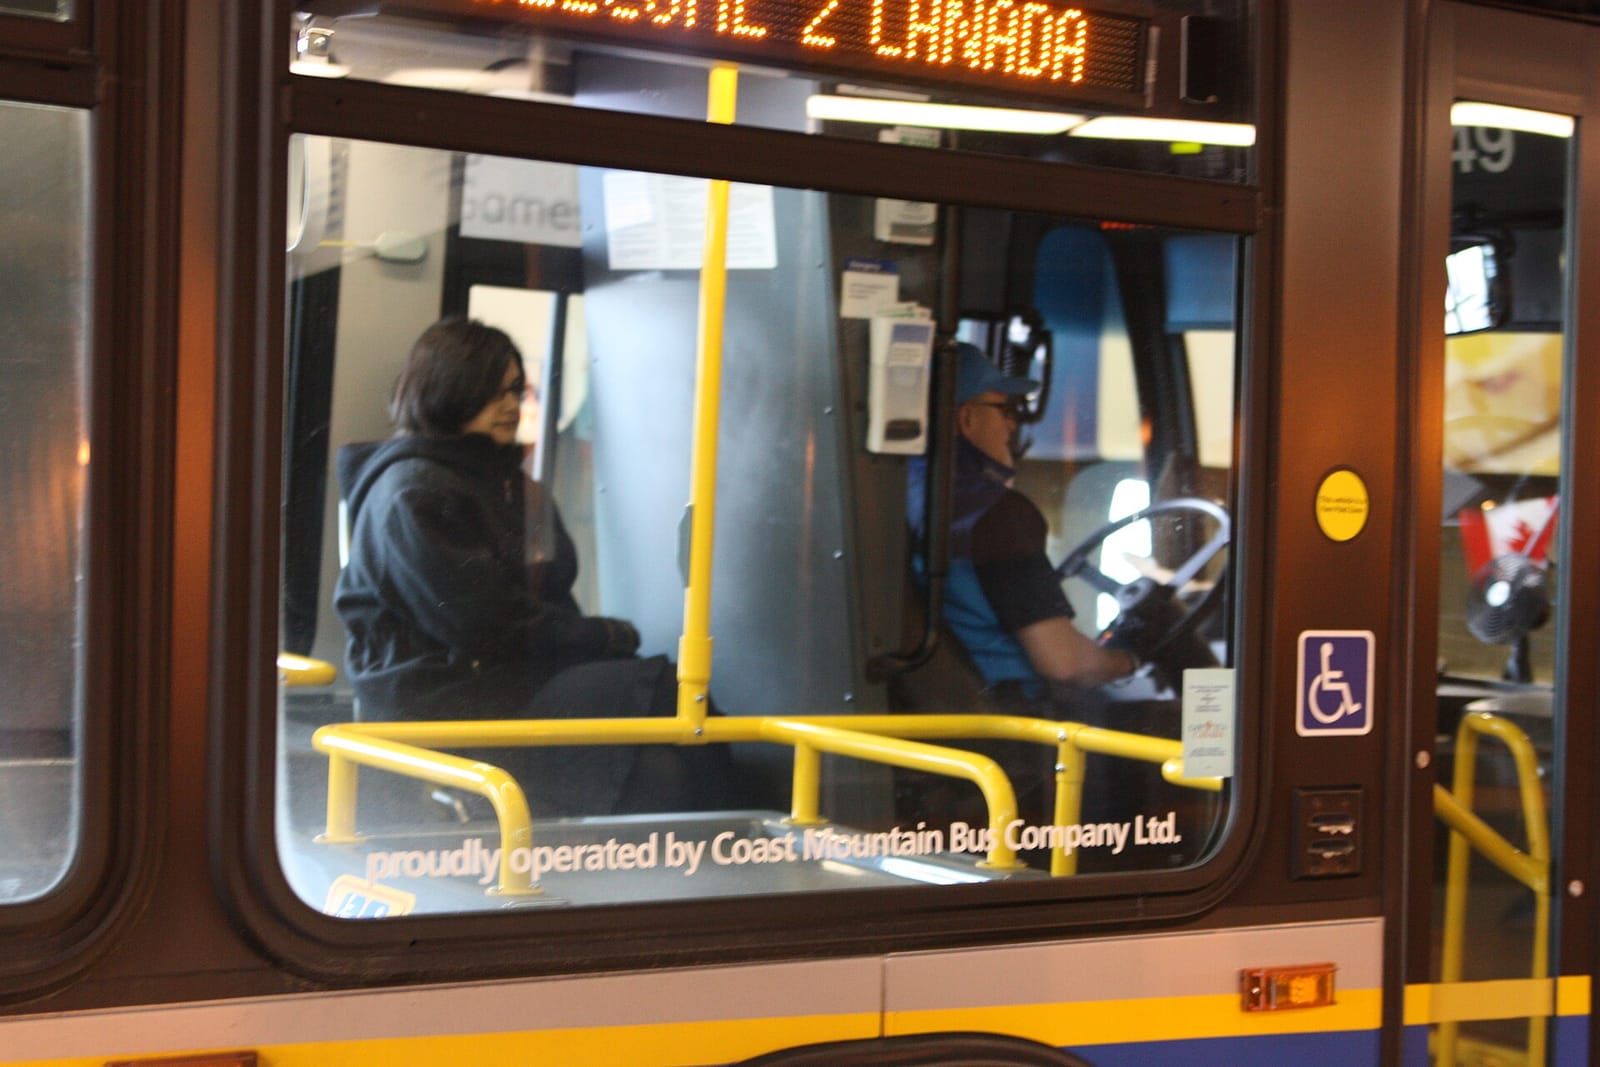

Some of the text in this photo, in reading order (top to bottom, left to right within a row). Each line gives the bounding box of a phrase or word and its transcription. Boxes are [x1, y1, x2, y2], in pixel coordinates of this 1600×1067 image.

[869, 0, 1087, 82] CANADA
[365, 811, 1182, 888] proudly operated by Coast Mountain Bus Company Ltd.
